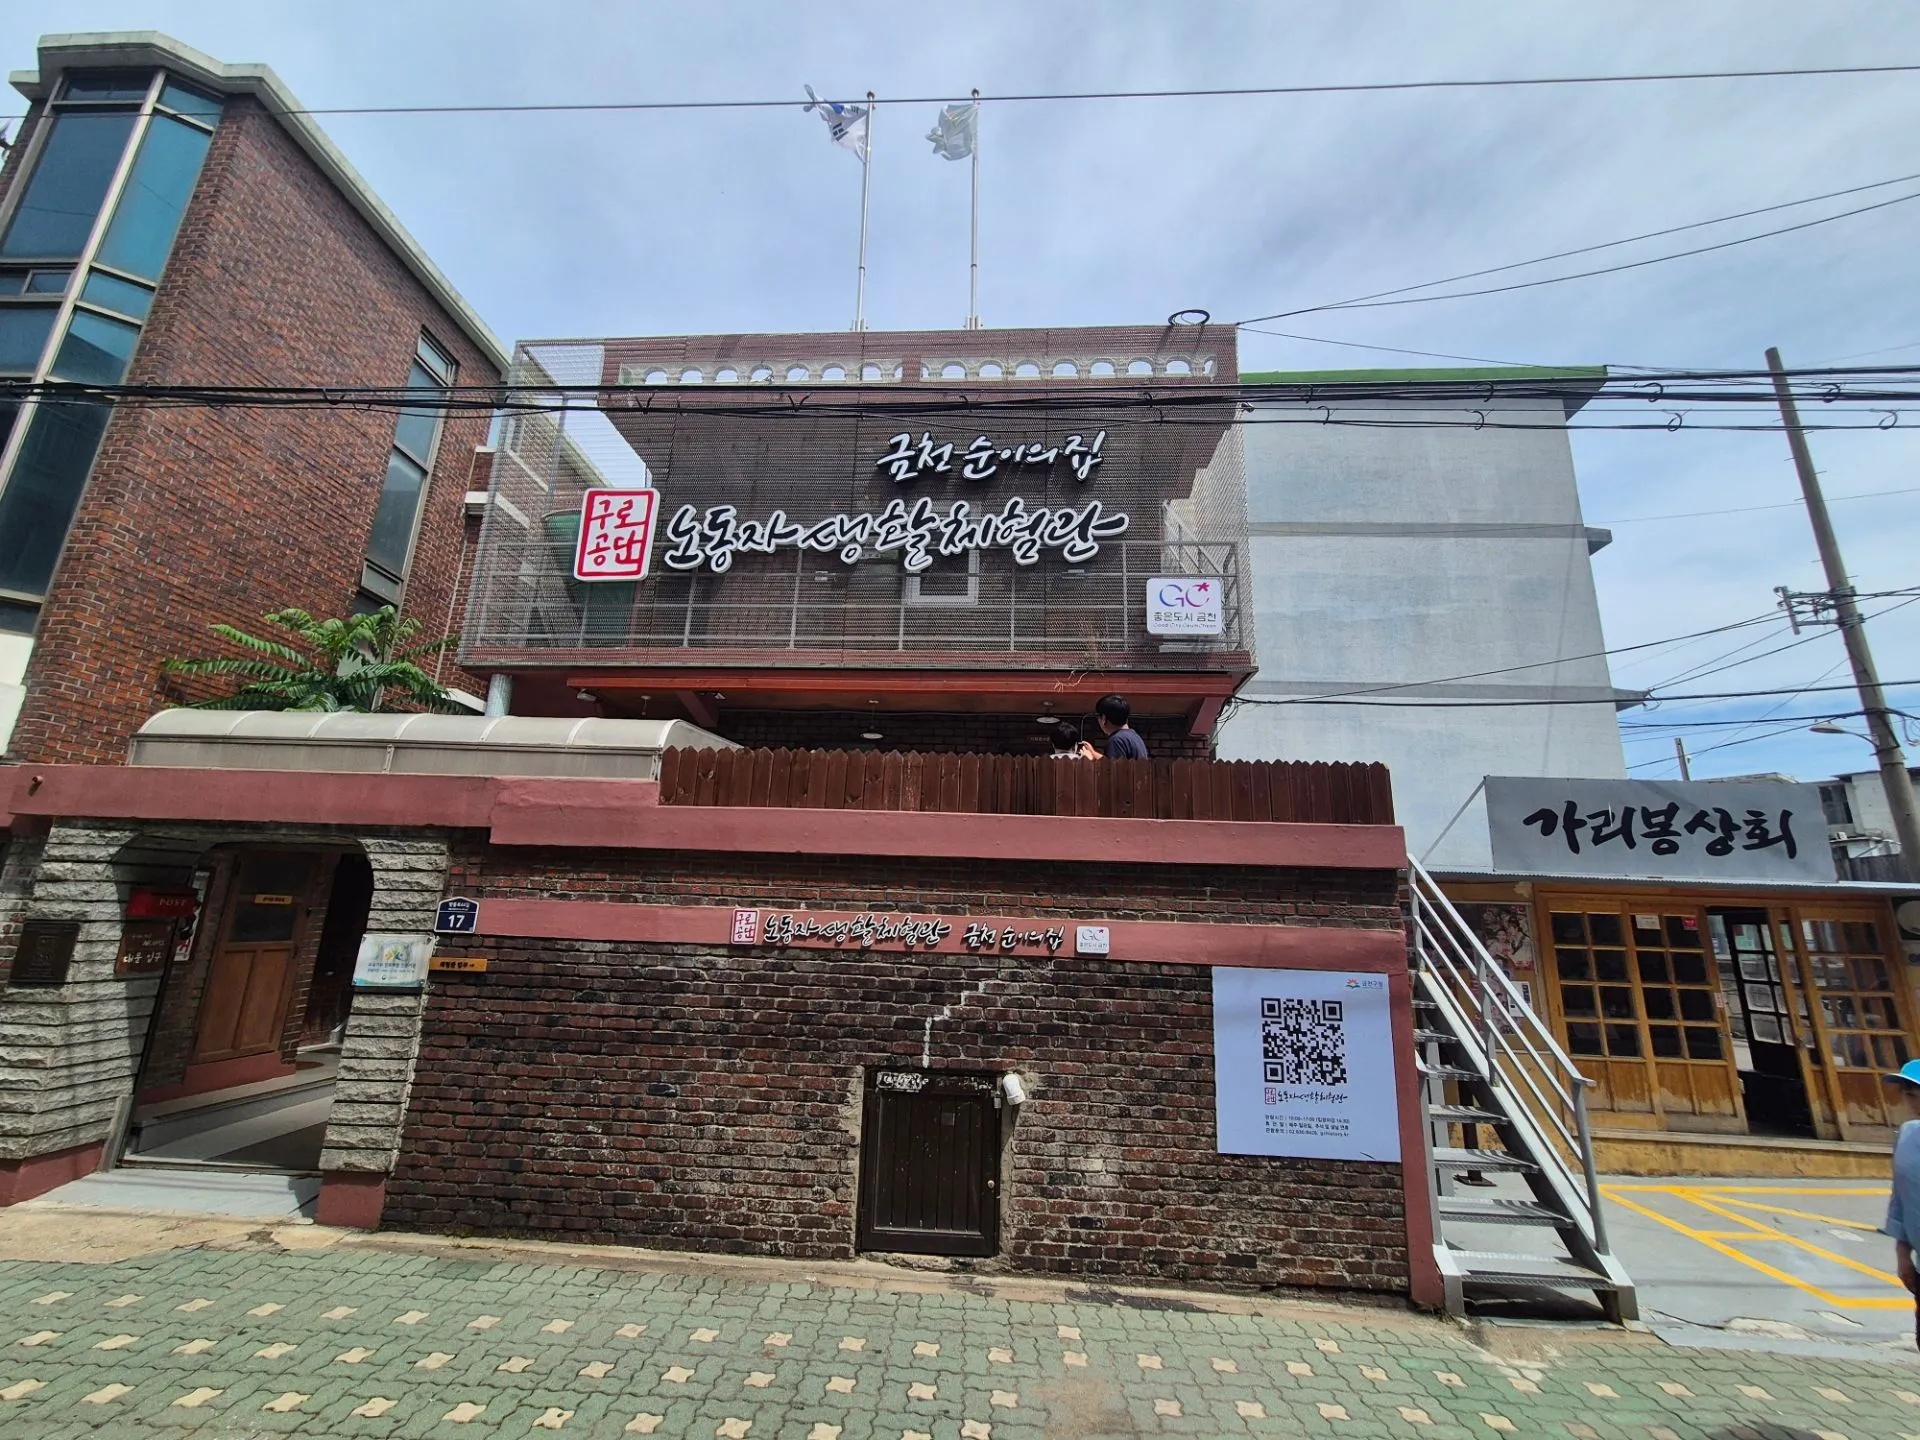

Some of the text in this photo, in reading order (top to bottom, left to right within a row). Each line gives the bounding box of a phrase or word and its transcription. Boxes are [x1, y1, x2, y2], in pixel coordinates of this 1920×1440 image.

[878, 433, 952, 481] 금천
[589, 499, 648, 529] 구로
[586, 532, 643, 567] 공단
[1153, 611, 1217, 622] 좋은도시 금천
[1523, 800, 1798, 858] 가리봉상회
[448, 914, 465, 928] 17
[962, 922, 996, 948] 금천
